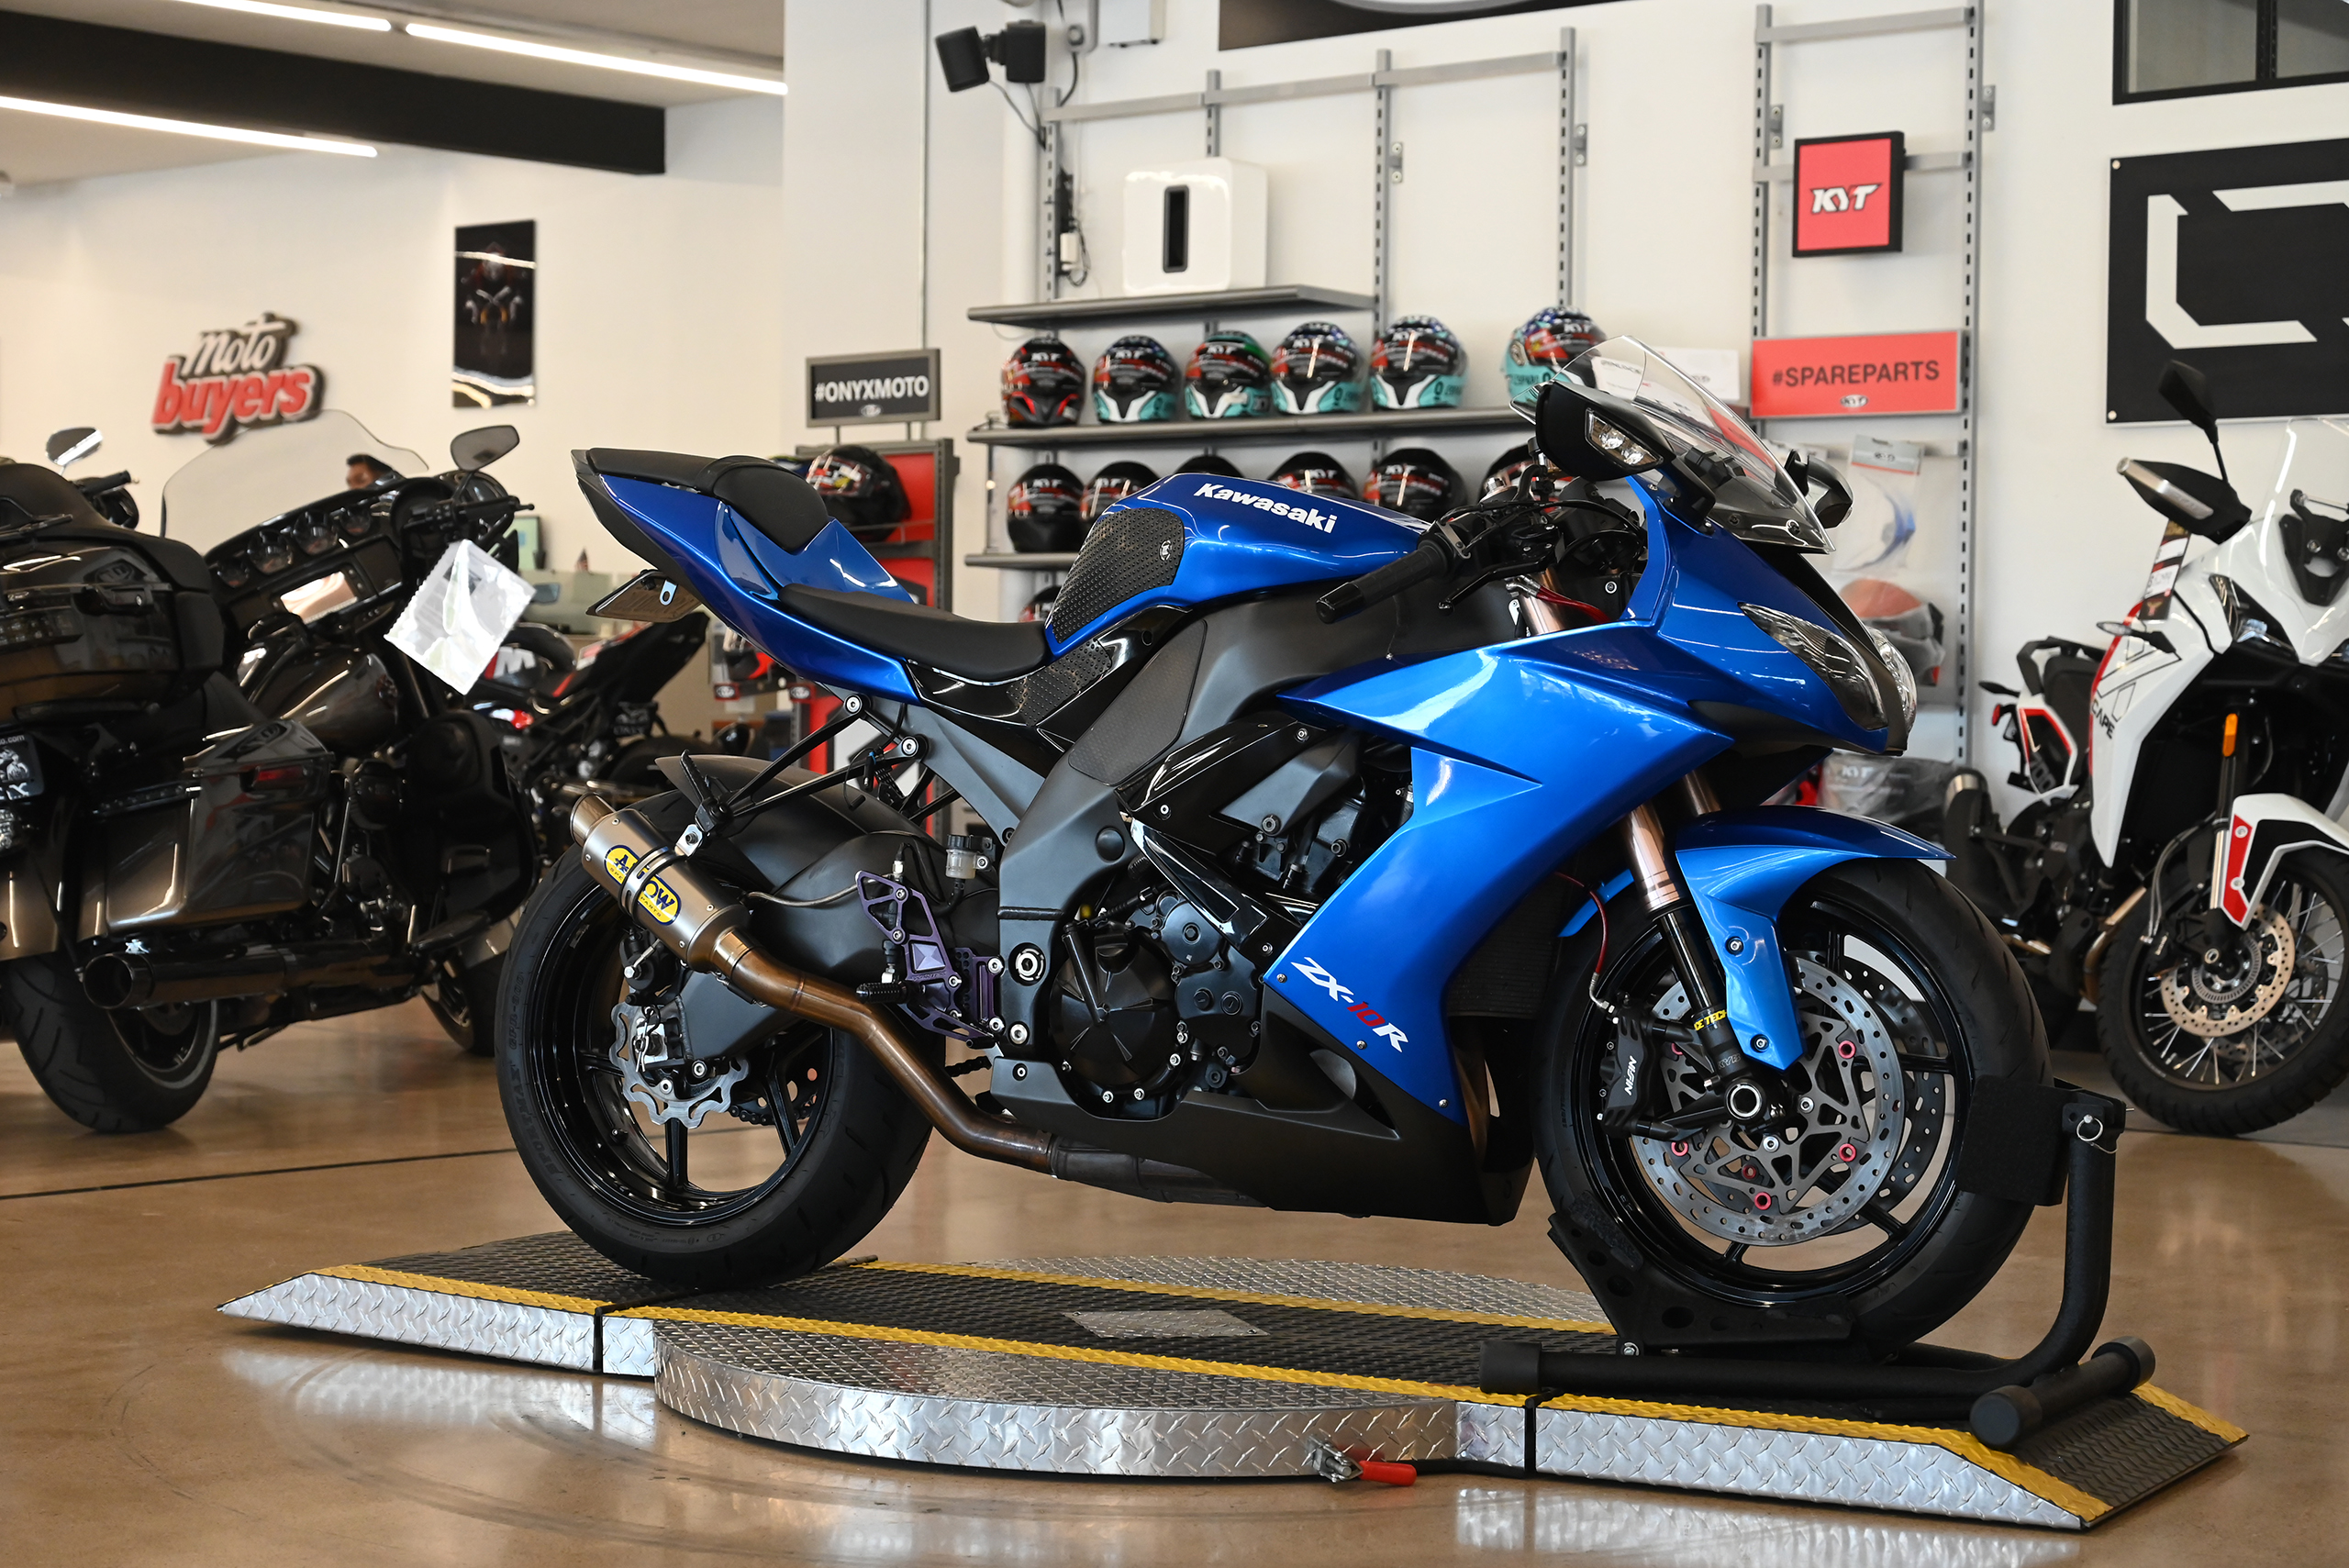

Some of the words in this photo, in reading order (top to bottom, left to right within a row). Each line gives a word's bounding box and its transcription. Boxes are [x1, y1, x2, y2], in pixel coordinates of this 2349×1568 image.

[1810, 183, 1883, 214] KYT
[815, 374, 930, 404] #ONYXMOTO
[1773, 361, 1940, 386] #SPAREPARTS
[150, 358, 314, 438] buyers
[1194, 483, 1338, 534] Kawasaki
[0, 735, 25, 745] o.com
[614, 854, 675, 910] AOW
[1291, 957, 1409, 1052] ZX-10R
[1624, 1055, 1638, 1096] NISSIN
